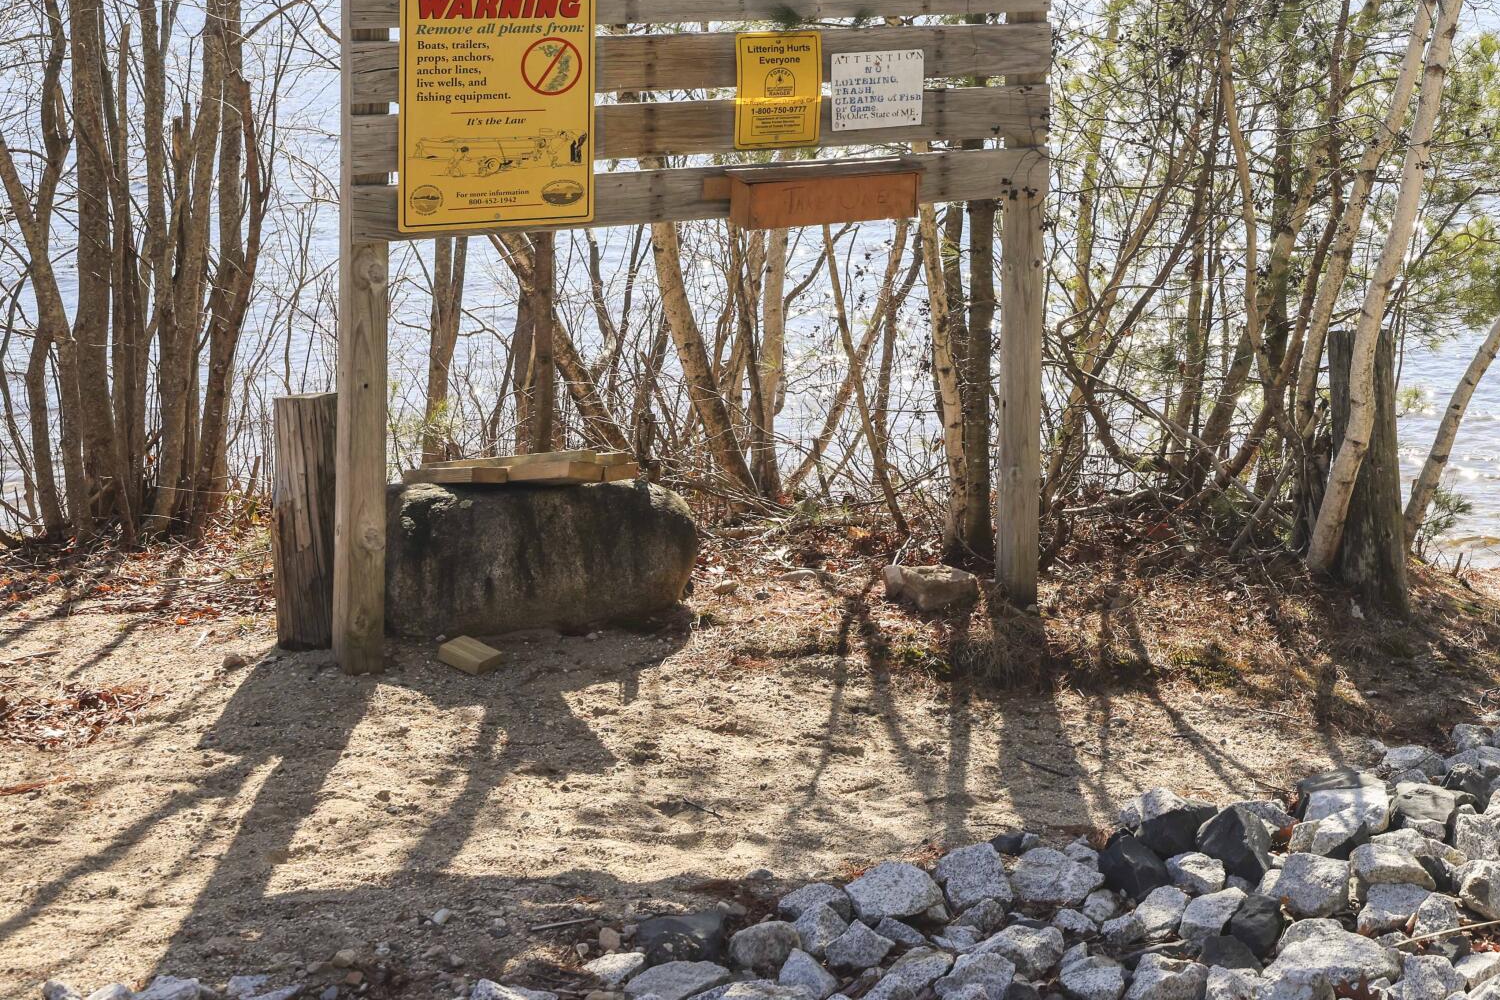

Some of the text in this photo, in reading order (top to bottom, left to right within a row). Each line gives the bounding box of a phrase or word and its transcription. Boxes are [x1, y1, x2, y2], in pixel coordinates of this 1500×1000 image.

[416, 22, 585, 37] Remove all plants from:
[417, 40, 490, 50] Boats, trailers,
[748, 44, 810, 54] Littering Hurts
[417, 52, 494, 65] props, anchors,
[760, 56, 800, 65] Everyone
[834, 51, 923, 64] ATTENTION
[416, 65, 481, 75] anchor lines,
[416, 77, 487, 88] live wells, and
[416, 92, 511, 103] fishing equipment.
[899, 93, 921, 102] Fish
[752, 106, 807, 115] 1-800-750-9777
[892, 109, 899, 117] of
[467, 118, 483, 126] It's
[485, 117, 502, 125] the
[469, 197, 517, 205] 800-452-1942
